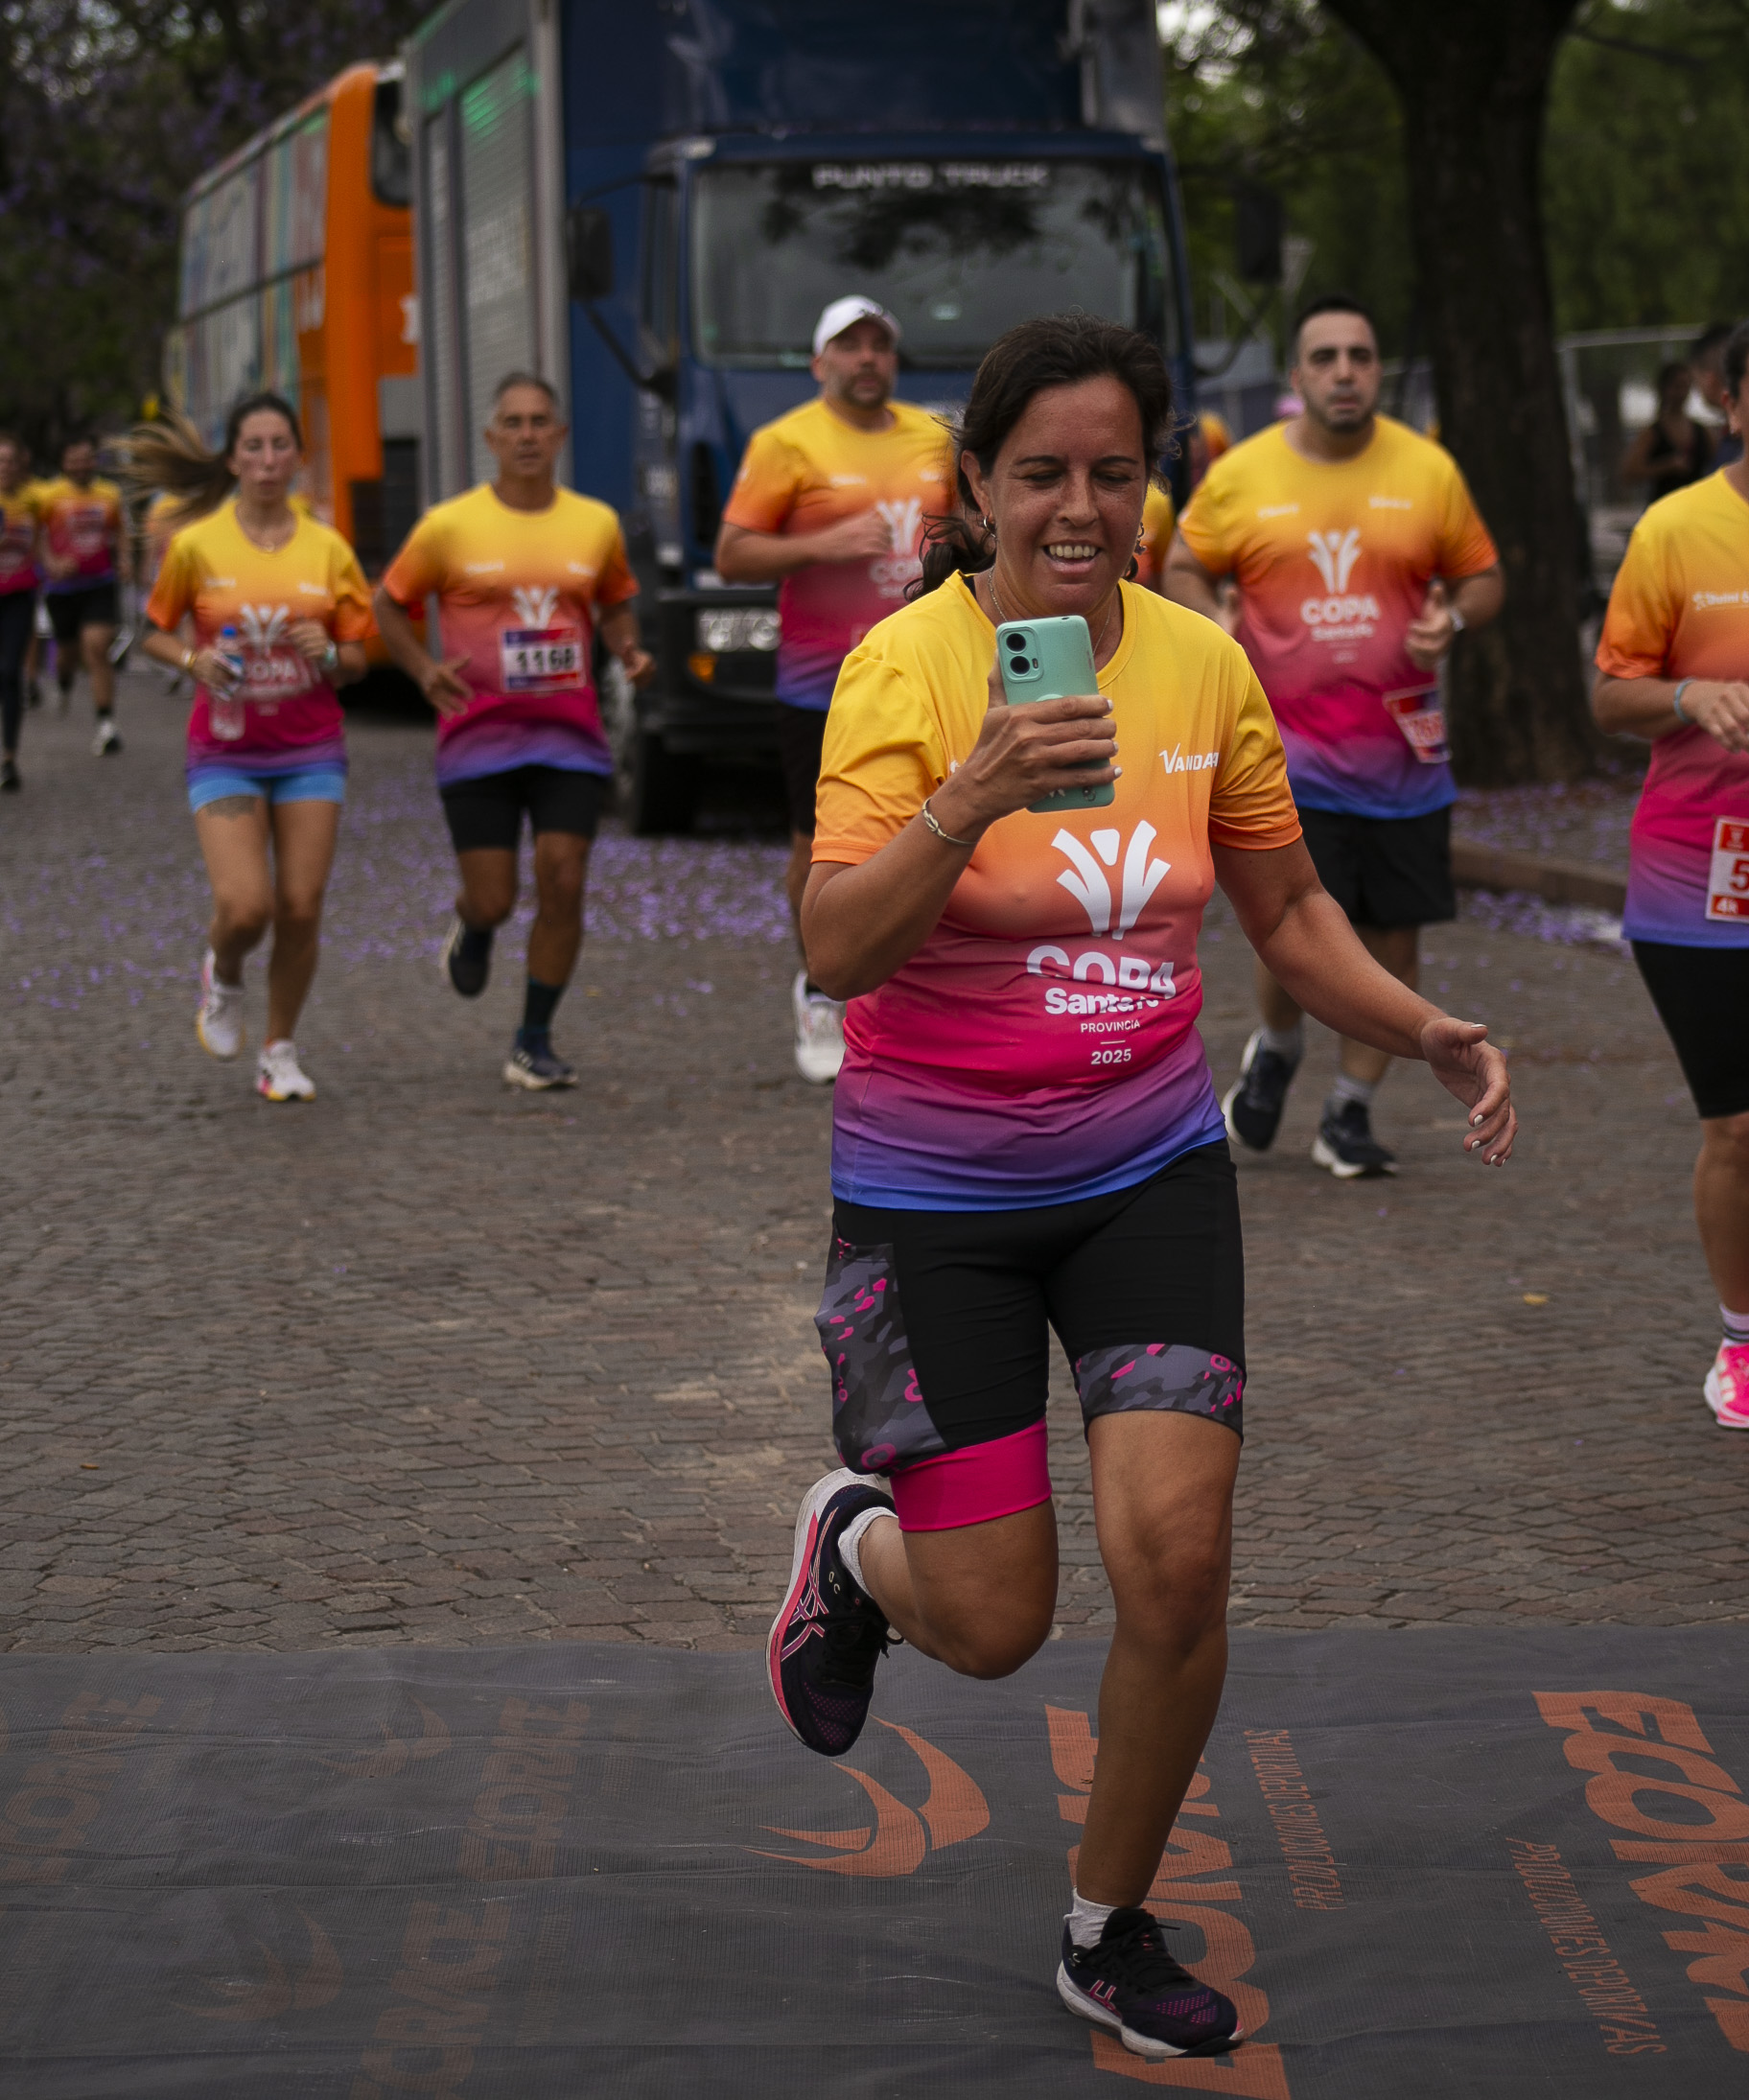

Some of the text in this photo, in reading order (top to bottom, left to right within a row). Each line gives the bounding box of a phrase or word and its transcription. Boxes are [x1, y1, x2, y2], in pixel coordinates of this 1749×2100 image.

[812, 163, 1050, 189] PUNTO TRUCK
[1300, 595, 1382, 625] COPA
[1080, 1019, 1141, 1034] PROVINCIA
[1090, 1048, 1131, 1065] 2025
[1244, 1730, 1312, 1800] DEPORTIVAS
